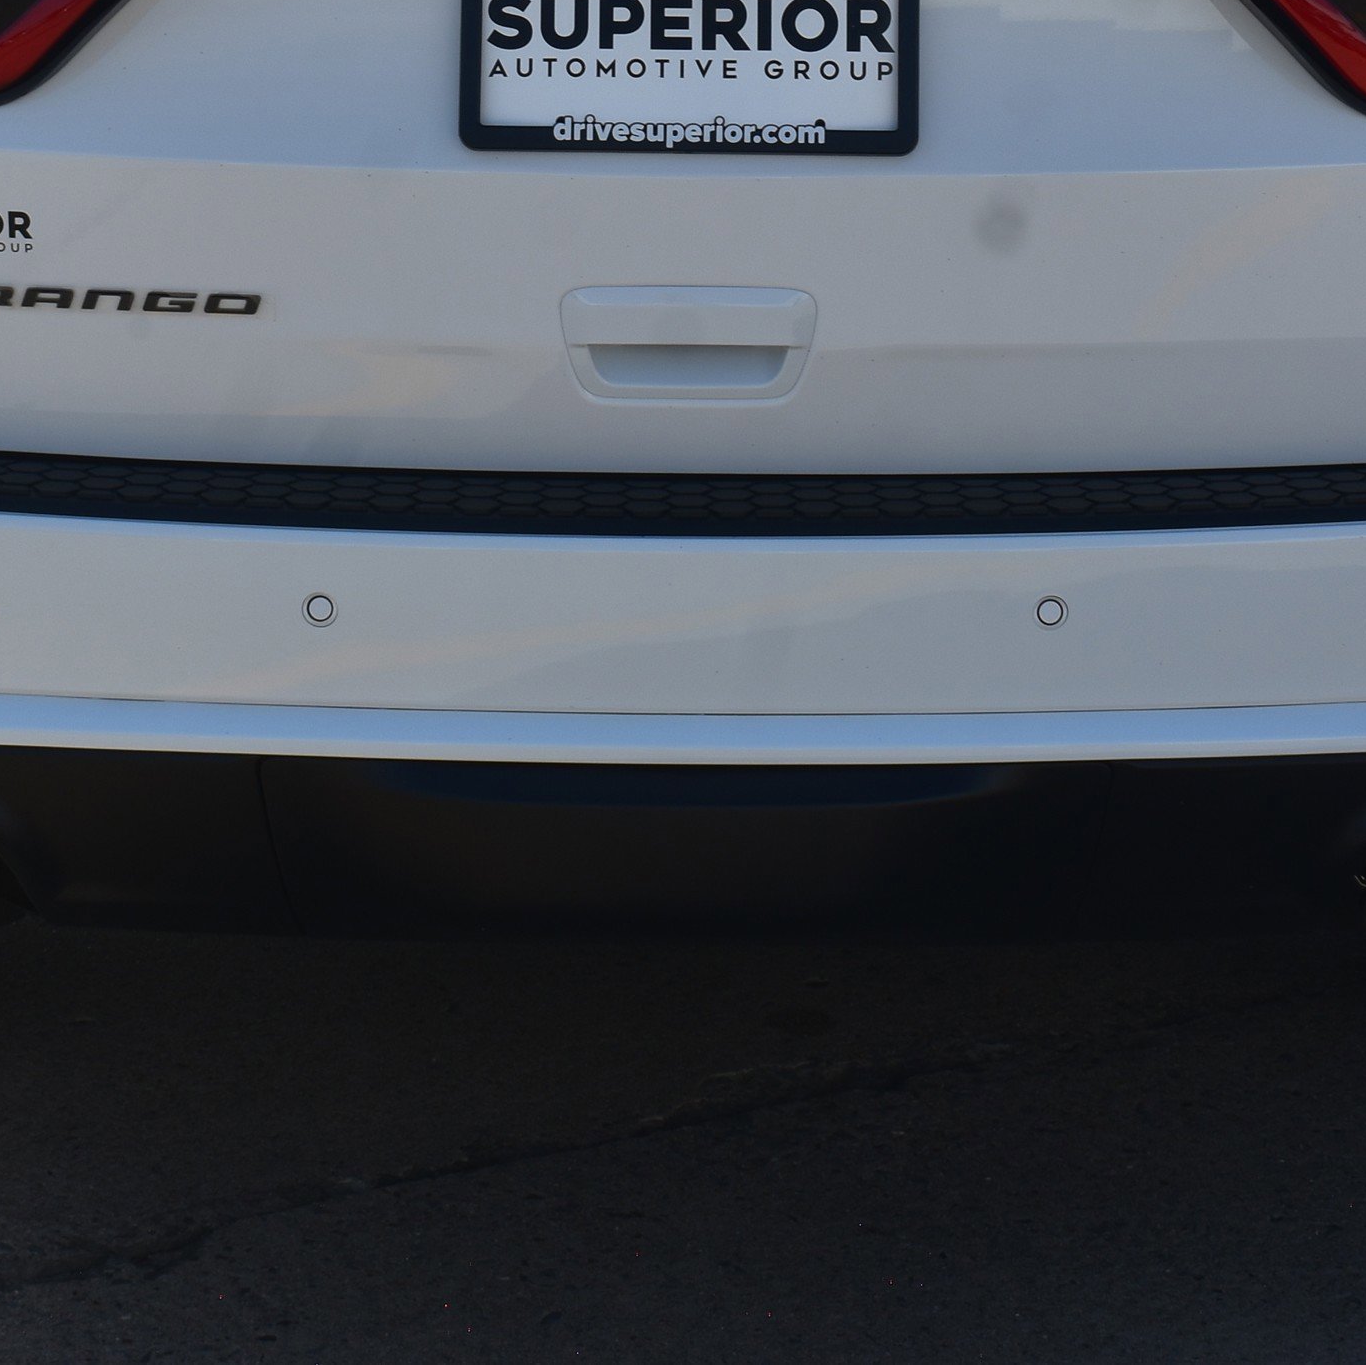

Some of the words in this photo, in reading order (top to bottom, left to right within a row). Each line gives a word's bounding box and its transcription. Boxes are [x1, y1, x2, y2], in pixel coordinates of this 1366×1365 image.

[489, 57, 738, 79] AUTOMOTIVE
[764, 60, 893, 81] GROUP
[553, 116, 825, 148] drivesuperior.com
